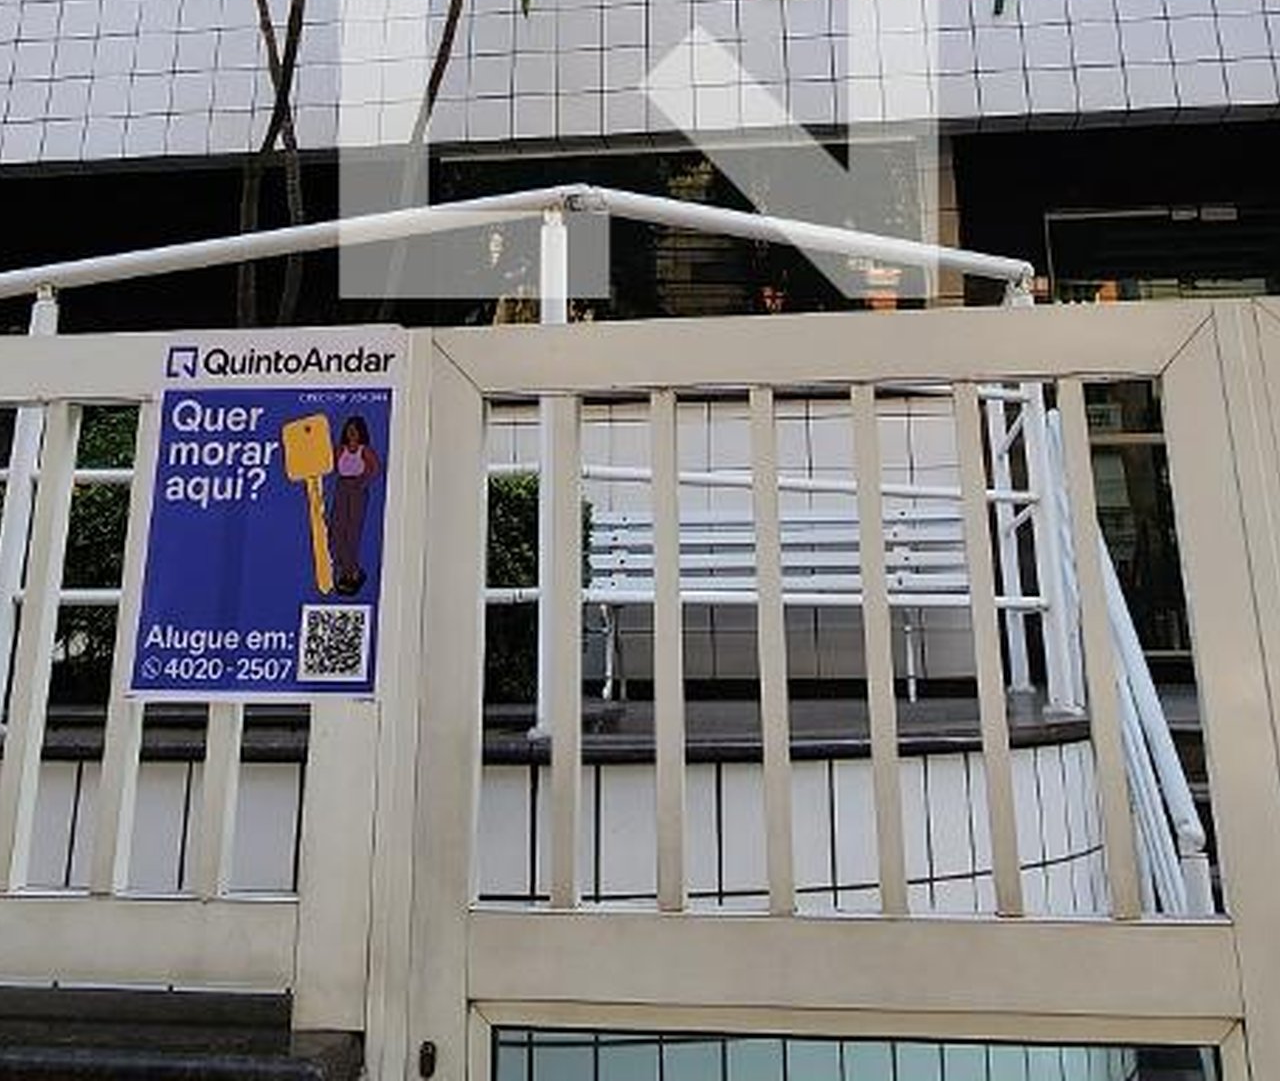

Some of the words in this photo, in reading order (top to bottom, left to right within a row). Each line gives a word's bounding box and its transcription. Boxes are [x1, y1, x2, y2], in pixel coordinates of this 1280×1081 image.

[203, 347, 395, 377] QuintoAndar
[171, 399, 264, 432] Quer
[168, 440, 278, 466] morar
[165, 468, 266, 508] aqui?
[144, 624, 239, 655] Alugue
[245, 629, 295, 650] em:
